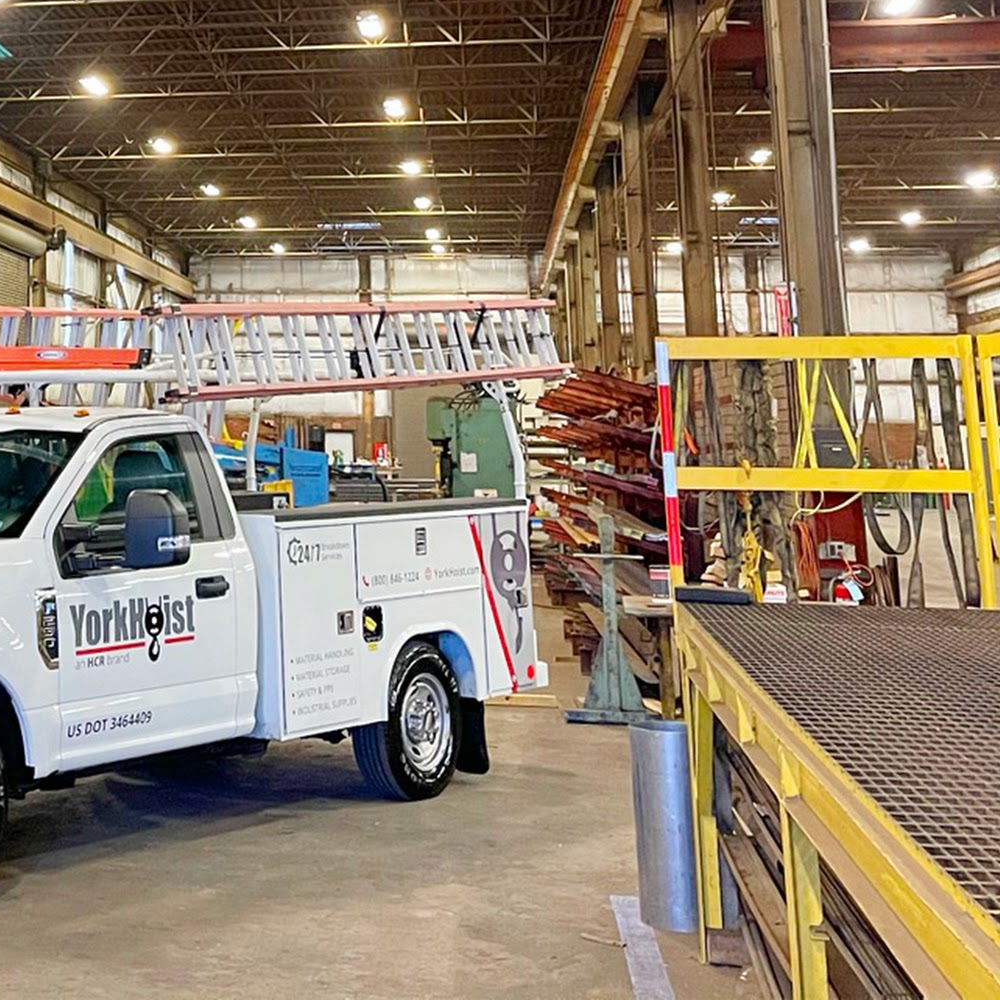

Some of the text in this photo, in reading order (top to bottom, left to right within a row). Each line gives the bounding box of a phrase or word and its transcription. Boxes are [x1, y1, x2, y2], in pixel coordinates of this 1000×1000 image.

[87, 655, 105, 668] HCR
[106, 653, 130, 666] brand
[67, 710, 152, 738] US DOT 3464409
